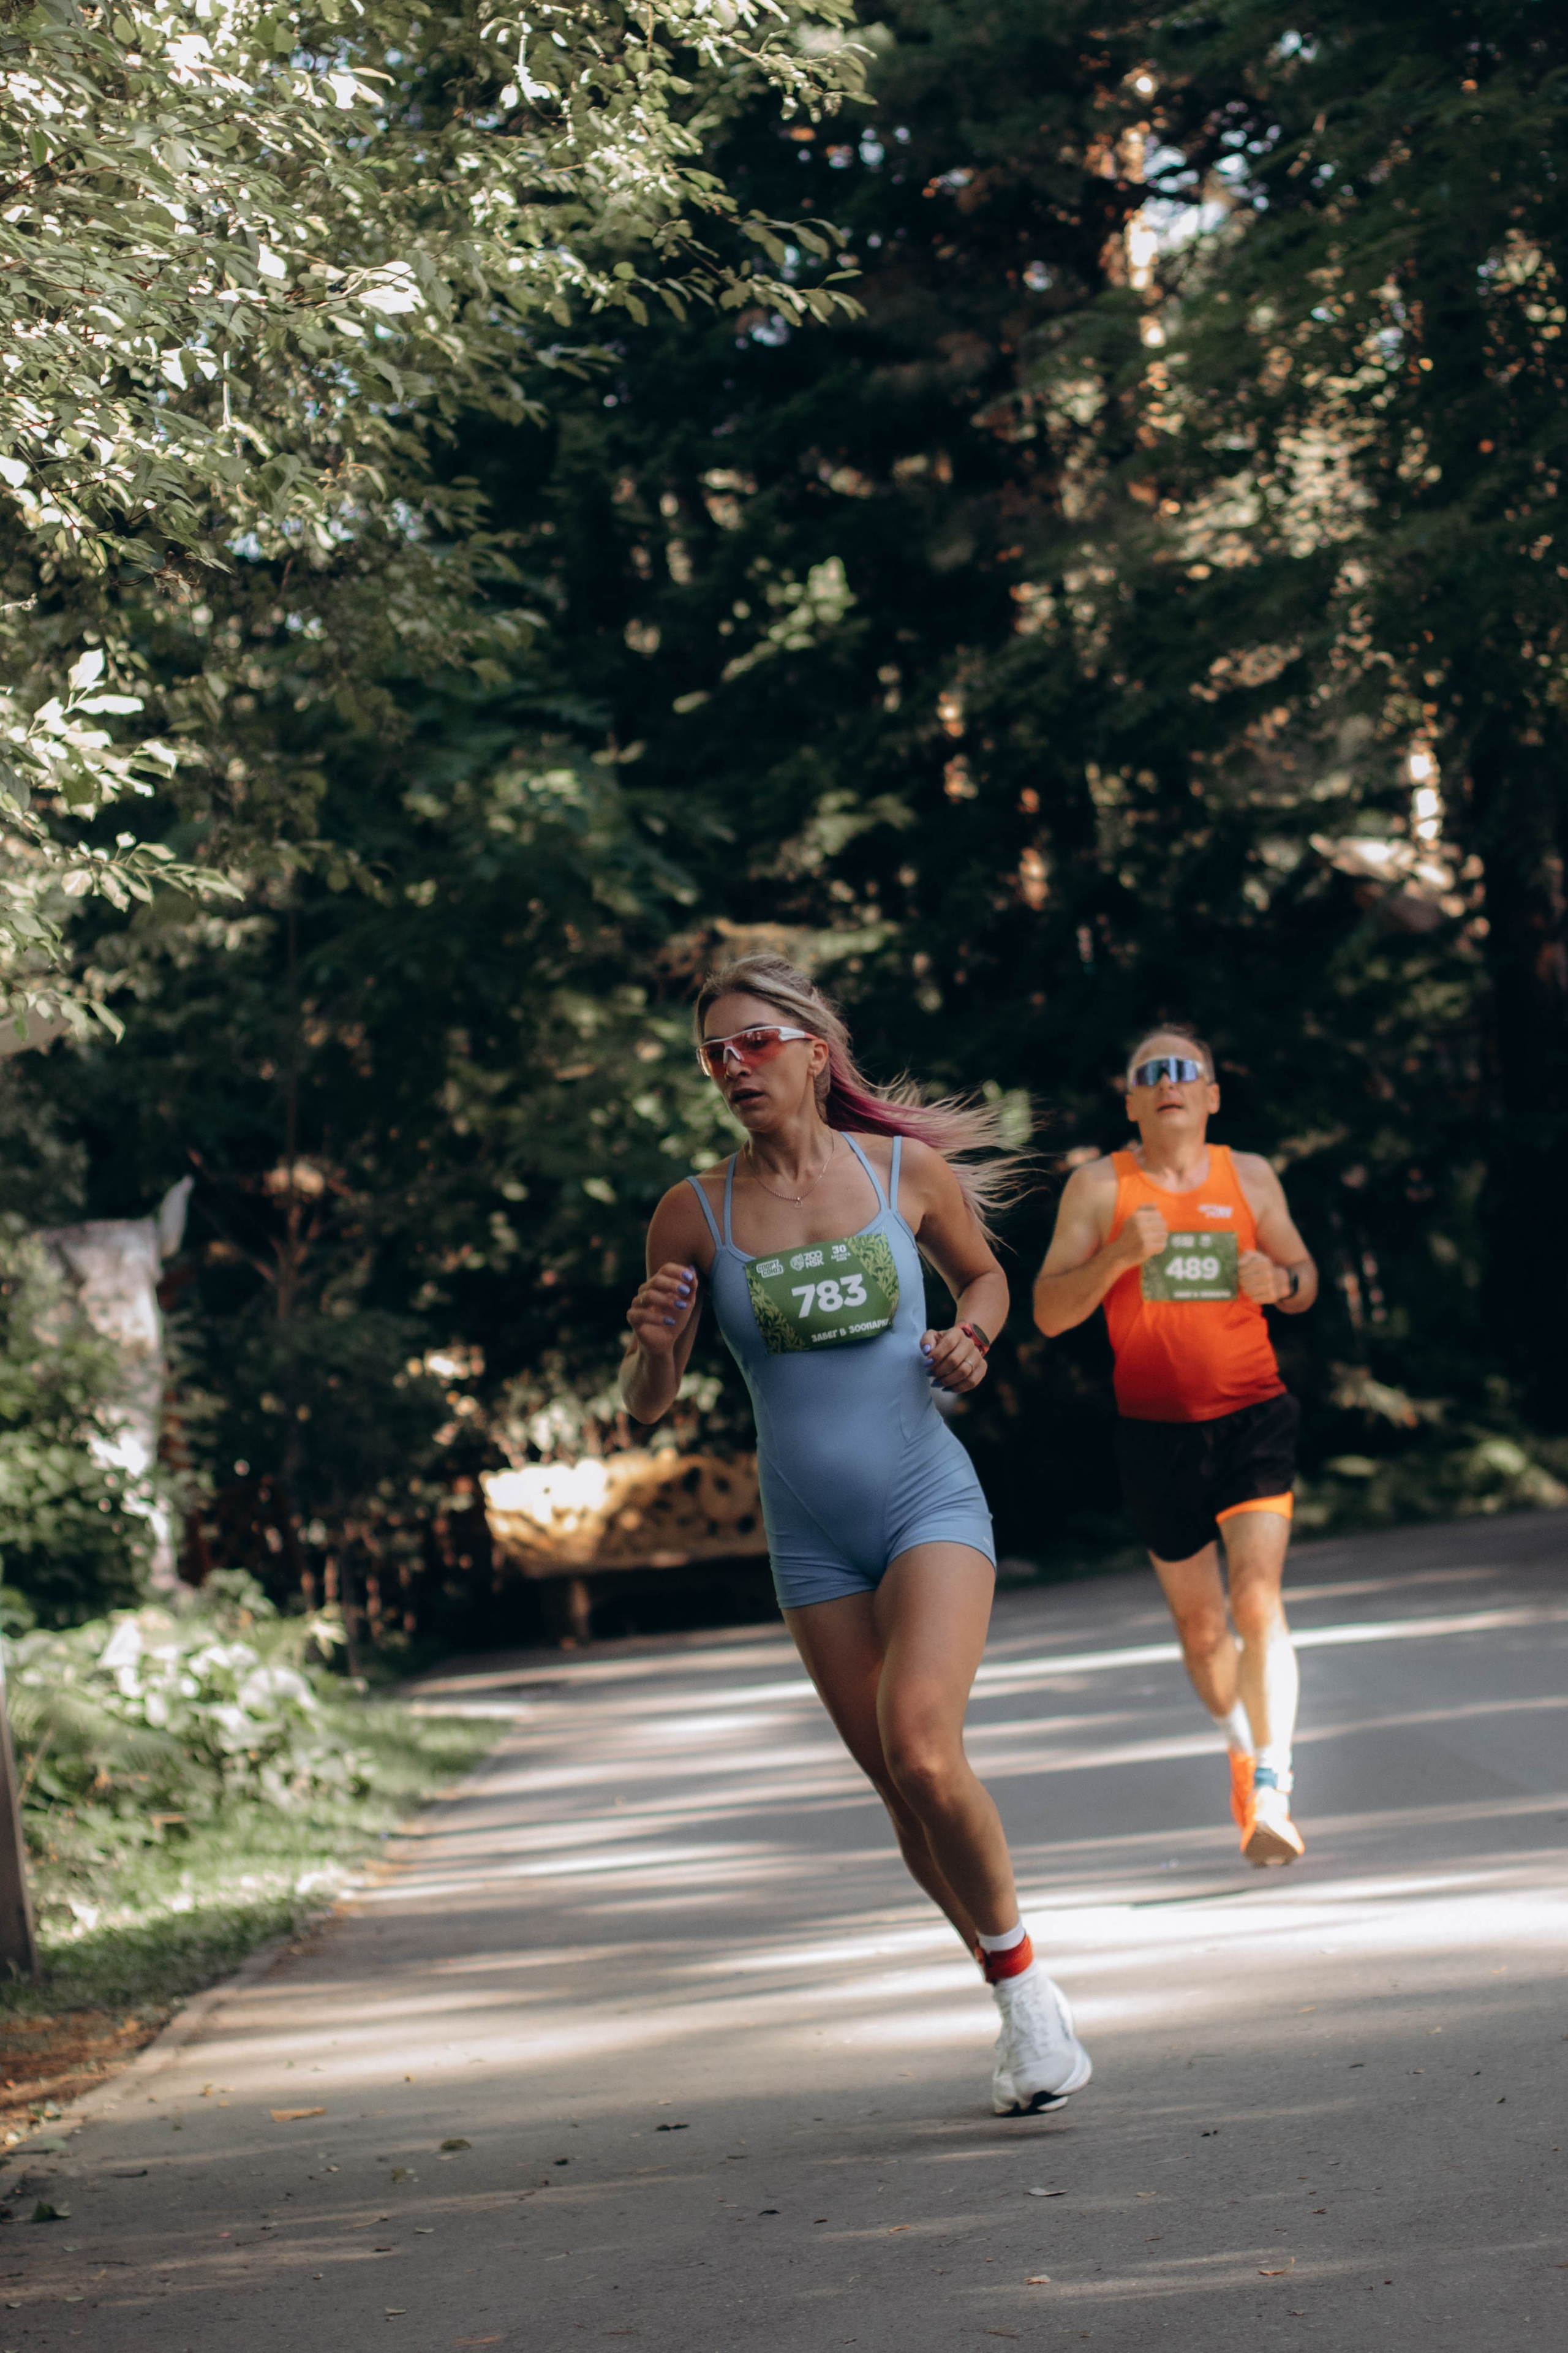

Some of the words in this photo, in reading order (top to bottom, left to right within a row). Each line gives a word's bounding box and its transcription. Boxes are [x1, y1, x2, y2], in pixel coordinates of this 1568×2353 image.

[832, 1244, 846, 1254] 30
[803, 1250, 823, 1260] ZOO
[805, 1257, 824, 1268] NSK
[1165, 1256, 1220, 1280] 489
[791, 1274, 867, 1318] 783
